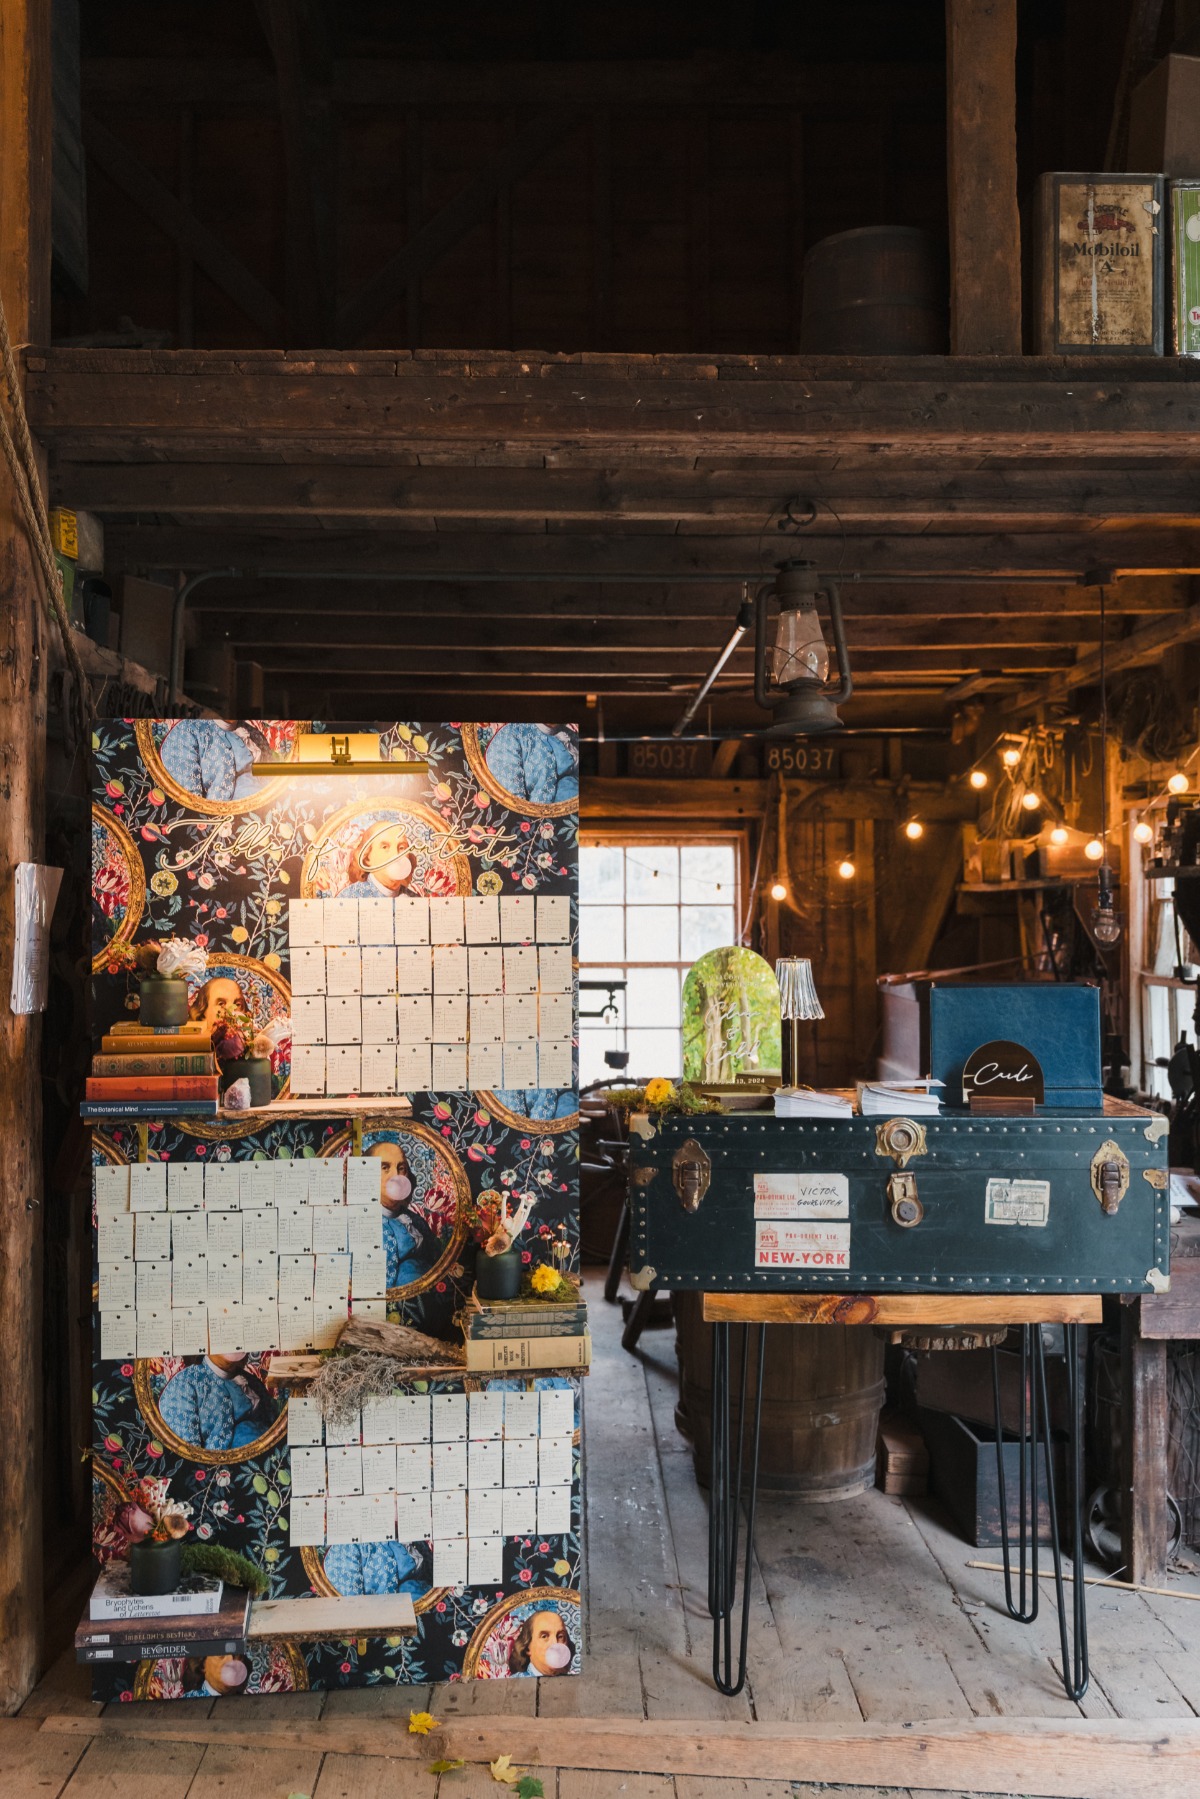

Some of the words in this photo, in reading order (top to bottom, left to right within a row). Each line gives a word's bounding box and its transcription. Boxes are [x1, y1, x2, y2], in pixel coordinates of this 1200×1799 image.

[1073, 242, 1139, 257] Mobiloil
[633, 744, 698, 769] 85037
[767, 748, 834, 770] 85037
[160, 815, 284, 871] Table
[303, 831, 336, 882] of
[358, 822, 521, 872] Contents
[974, 1062, 1033, 1085] Cards
[800, 1187, 839, 1197] VICTOR
[759, 1251, 846, 1265] NEW-YORK
[105, 1598, 144, 1607] Bryophytes
[128, 1603, 154, 1612] Lichens
[141, 1644, 190, 1655] BEYONDER
